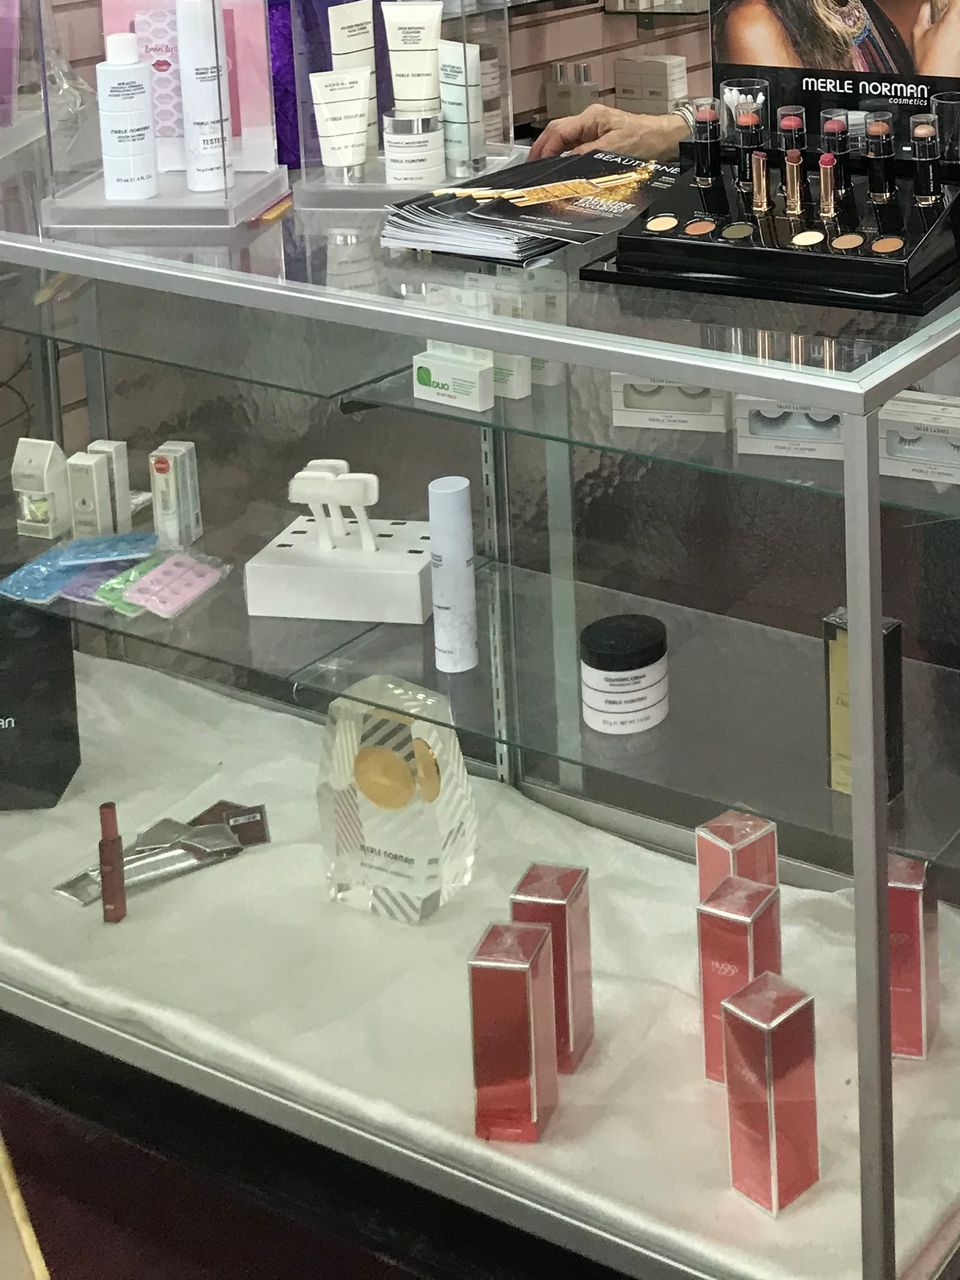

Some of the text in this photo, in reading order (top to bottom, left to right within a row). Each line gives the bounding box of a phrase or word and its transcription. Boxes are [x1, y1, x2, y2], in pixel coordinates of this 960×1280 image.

[802, 78, 927, 98] MERLE NORMAN
[888, 97, 928, 106] cosmetics
[593, 153, 646, 168] BEAUTY
[432, 380, 450, 391] DUO
